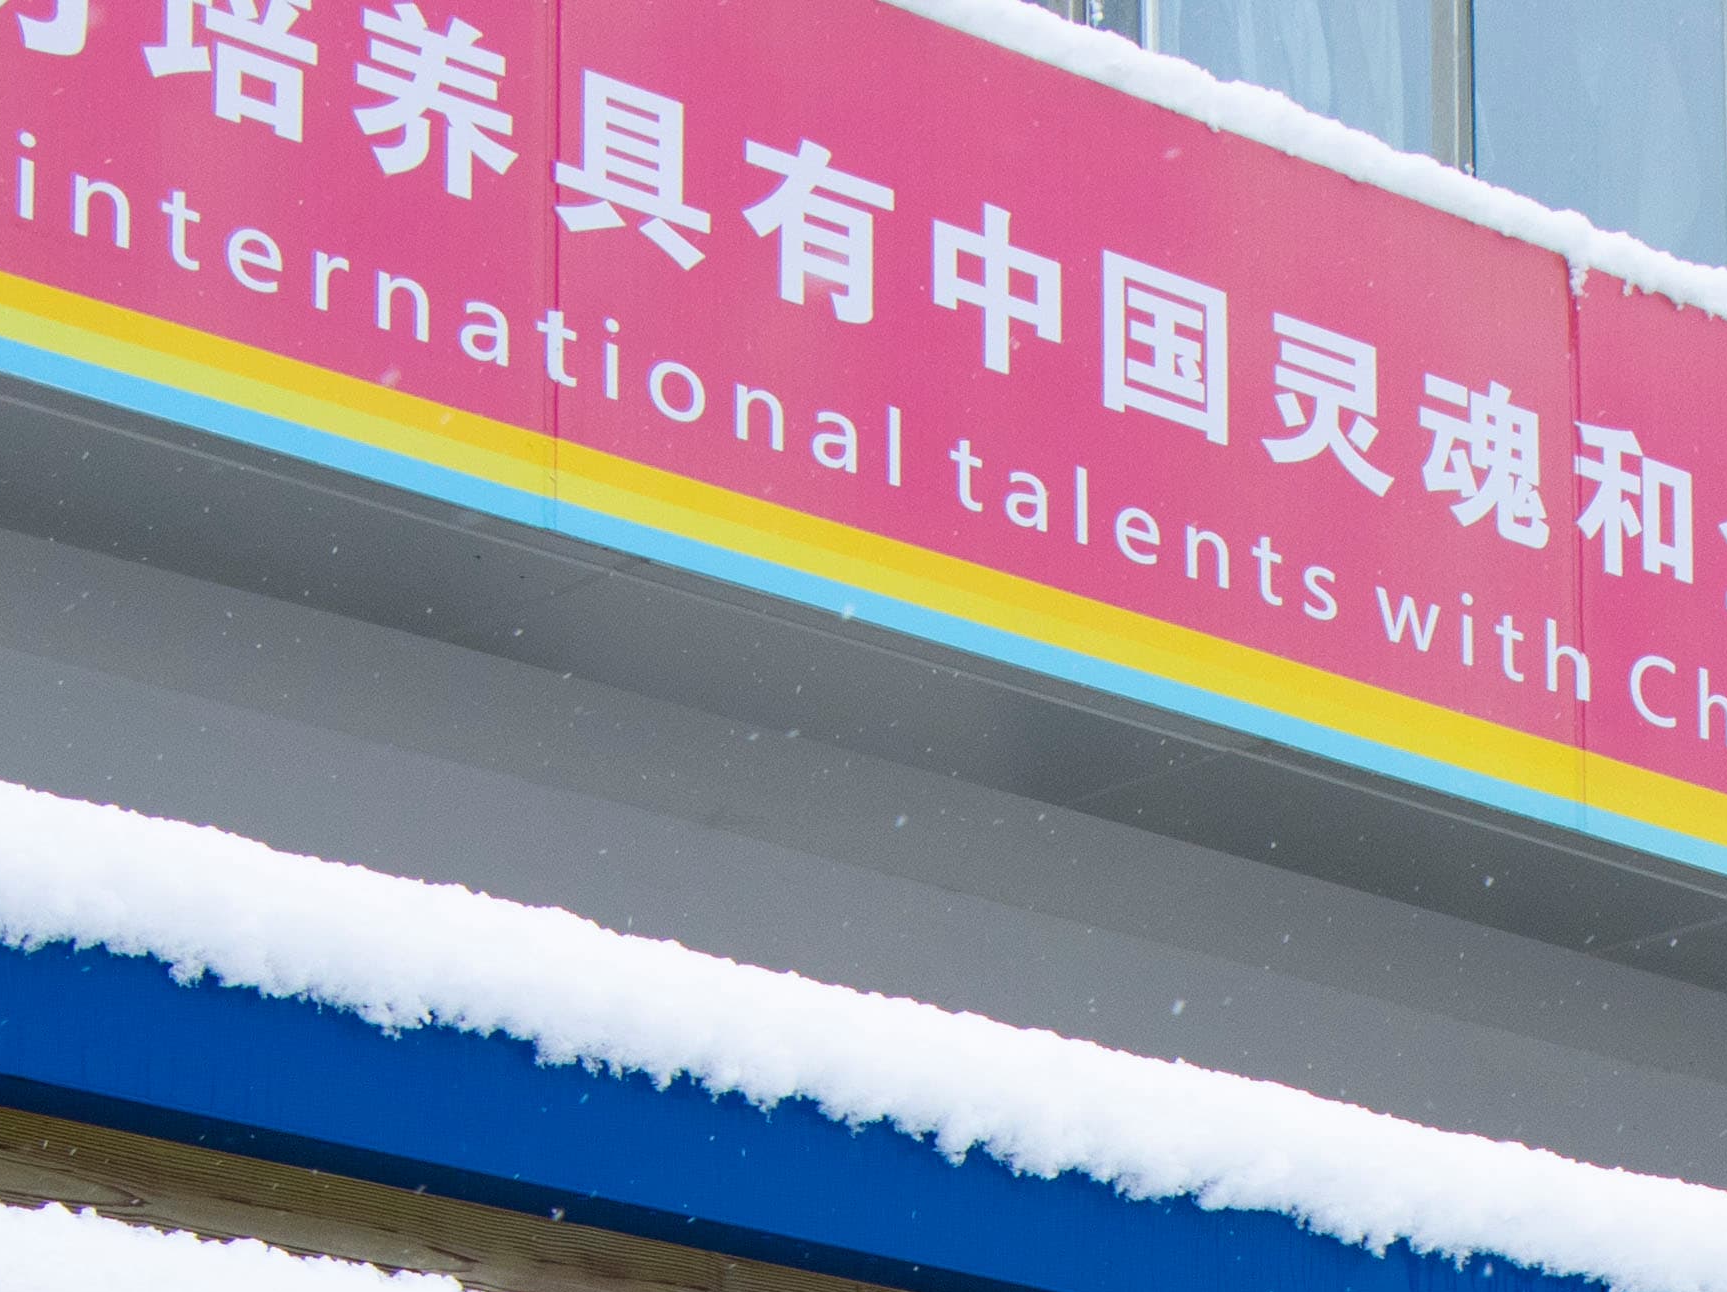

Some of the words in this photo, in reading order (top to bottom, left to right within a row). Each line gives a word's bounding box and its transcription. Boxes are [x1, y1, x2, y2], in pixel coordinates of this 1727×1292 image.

[17, 130, 901, 488] international
[955, 440, 1343, 624] talents
[1376, 580, 1594, 703] with
